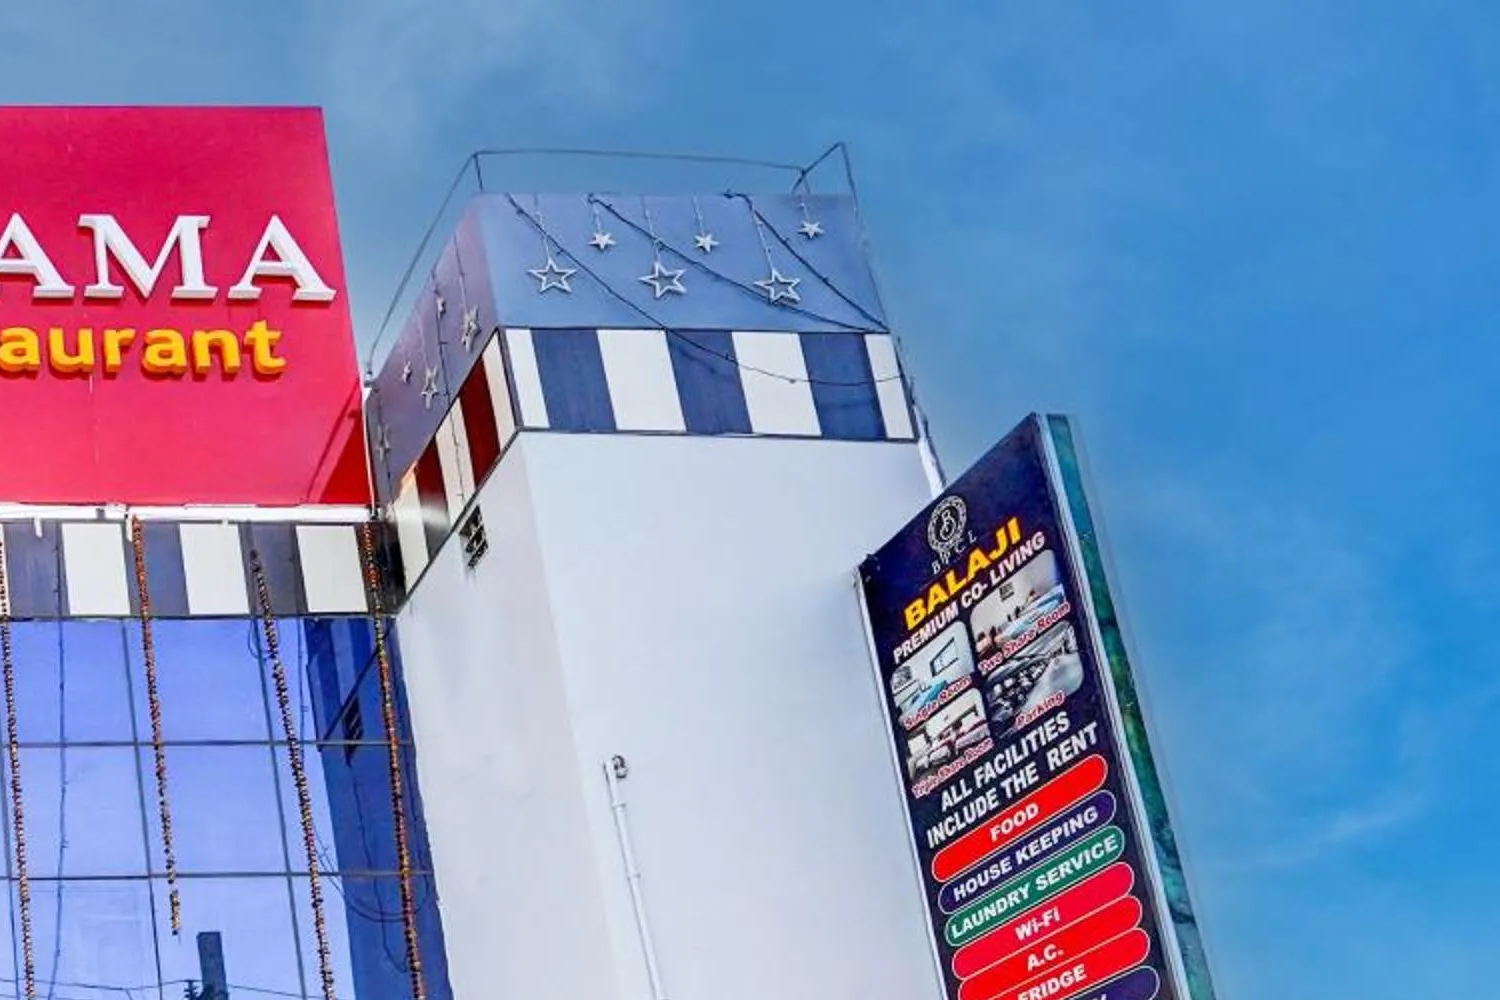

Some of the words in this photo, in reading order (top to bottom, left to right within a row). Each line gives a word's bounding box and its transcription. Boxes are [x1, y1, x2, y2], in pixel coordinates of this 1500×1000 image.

[892, 601, 960, 664] PREMIUM
[989, 531, 1046, 587] LIVING
[903, 517, 1022, 631] BALAJI
[1035, 601, 1071, 633] Room
[1015, 689, 1066, 730] Parking
[926, 788, 999, 849] INCLUDE
[1001, 765, 1039, 800] THE
[1049, 722, 1099, 772] RENT
[941, 779, 973, 812] ALL
[974, 711, 1070, 789] FACILITIES
[953, 860, 1013, 902] HOUSE
[1016, 806, 1099, 865] KEEPING
[989, 803, 1039, 842] FOOD
[950, 884, 1031, 939] LAUNDRY
[1035, 835, 1120, 892] SERVICE
[1027, 944, 1064, 972] A.C.
